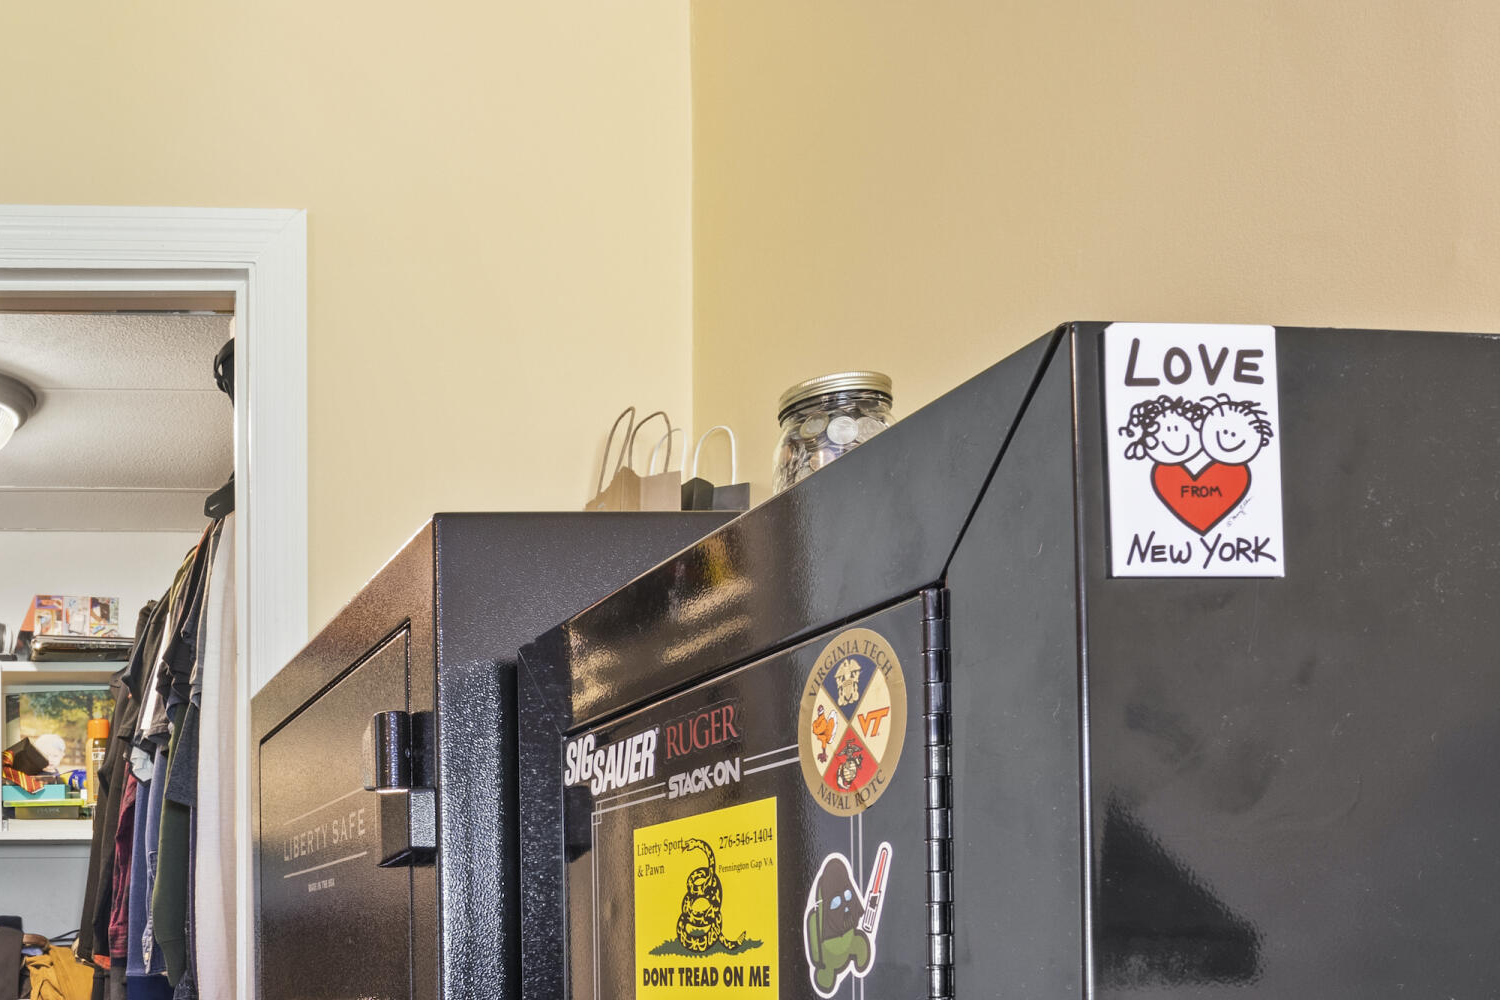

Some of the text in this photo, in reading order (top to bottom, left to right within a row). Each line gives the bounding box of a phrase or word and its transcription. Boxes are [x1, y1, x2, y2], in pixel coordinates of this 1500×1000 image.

[1124, 338, 1264, 387] LOVE
[1180, 485, 1222, 498] FROM
[1127, 531, 1277, 569] NEW YORK
[808, 639, 859, 698] VIRGINIA
[665, 704, 738, 760] RUGER
[857, 706, 891, 738] VT
[564, 728, 658, 796] SIG SAUER
[668, 757, 741, 800] STACK-ON
[817, 769, 886, 810] NAVAL ROTC
[283, 808, 366, 862] LIBERTY SAFE
[637, 841, 662, 857] Liberty
[718, 827, 773, 850] 276-546-1404
[637, 863, 665, 878] & Pawn
[718, 857, 774, 873] Pennington Gap VA
[643, 965, 770, 987] DONT TREAD ON ME
